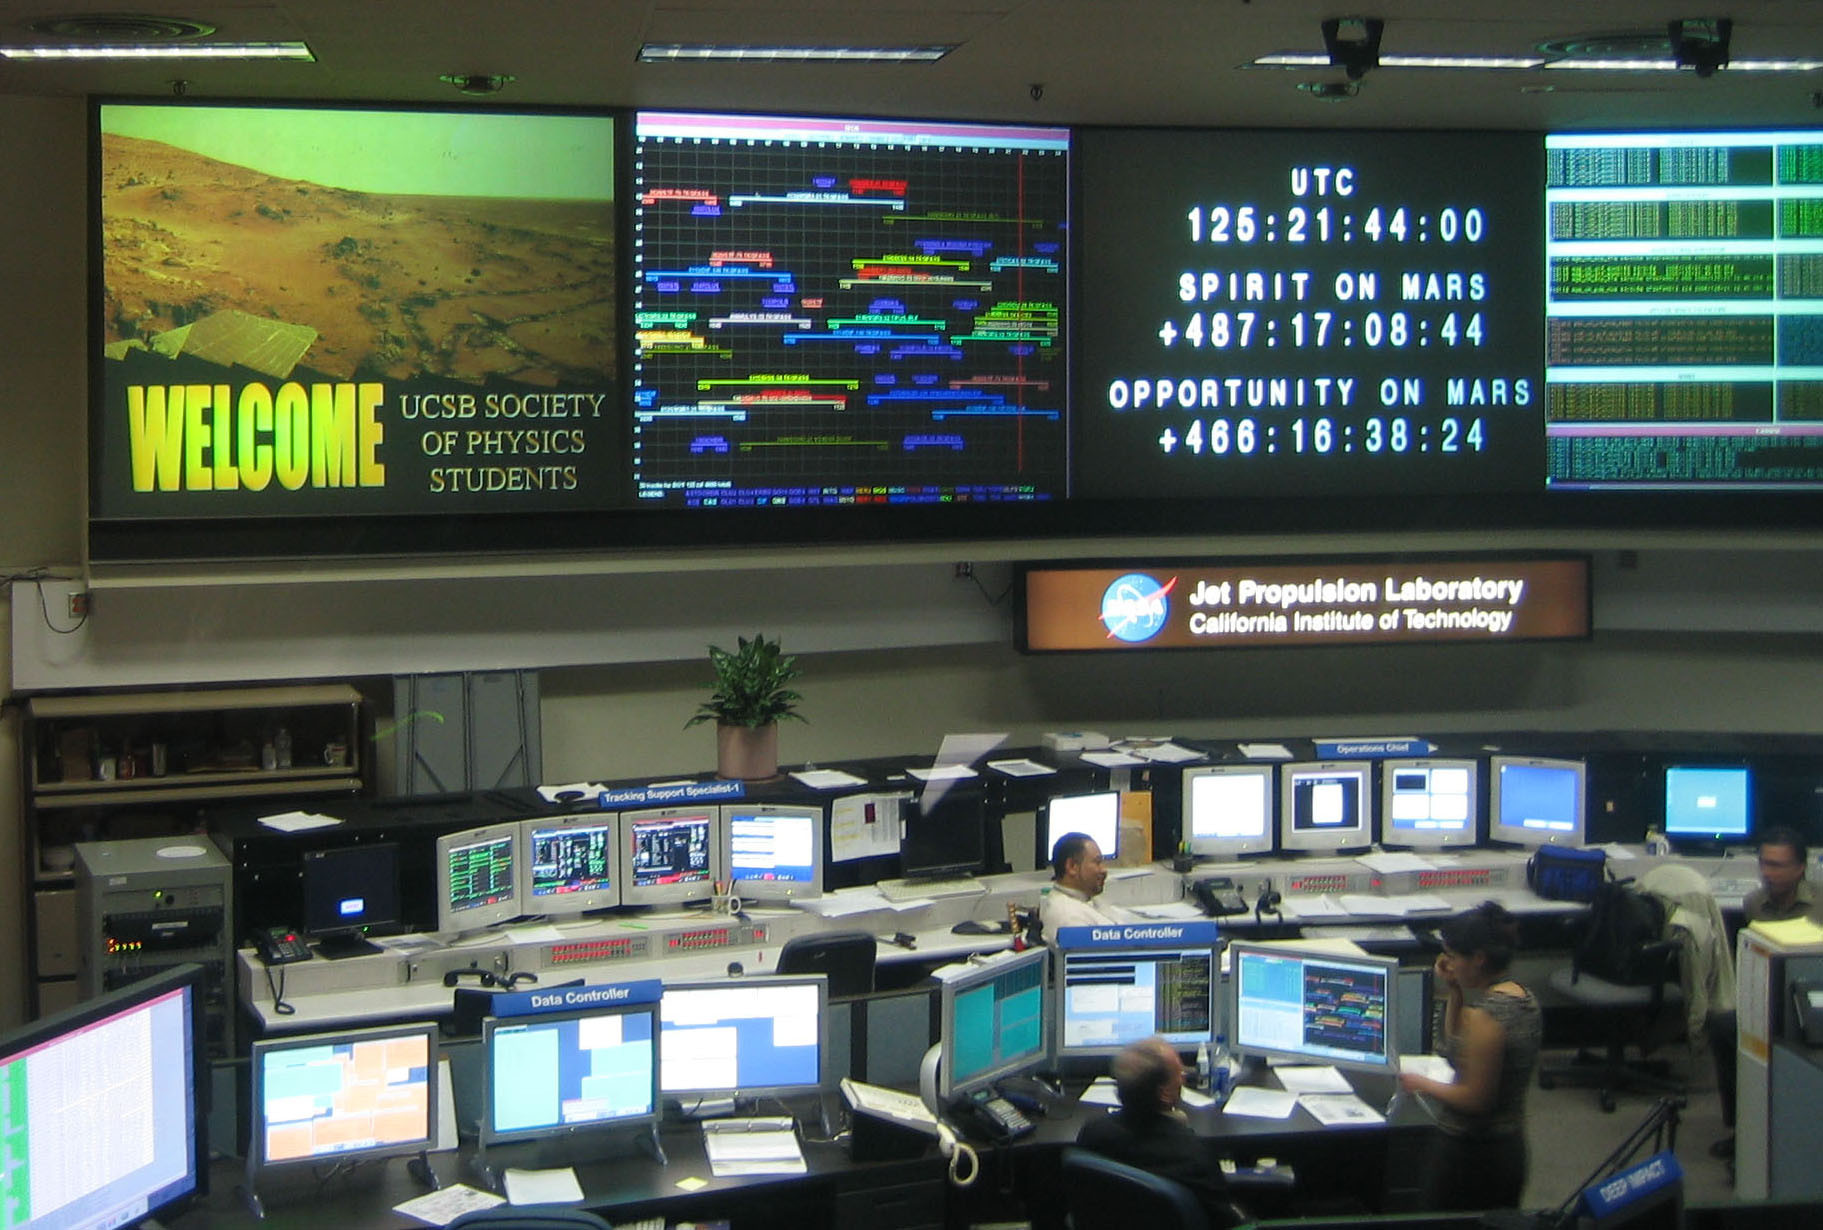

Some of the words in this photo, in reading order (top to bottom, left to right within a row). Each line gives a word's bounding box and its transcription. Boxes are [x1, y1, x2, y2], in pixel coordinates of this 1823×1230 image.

[1291, 168, 1353, 196] UTC
[1188, 207, 1482, 242] 125:21:44:00
[1179, 272, 1309, 301] SPIRIT
[1335, 273, 1377, 301] ON
[1402, 273, 1486, 300] MARS
[1158, 312, 1482, 348] +487:17:08:44
[400, 394, 477, 419] UCSB
[485, 394, 606, 418] SOCIETY
[1109, 379, 1356, 409] OPPORTUNITY
[1380, 379, 1420, 406] ON
[1447, 379, 1529, 405] MARS
[127, 383, 385, 492] WELCOME
[422, 431, 459, 456] OF
[467, 430, 585, 455] PHYSICS
[1158, 418, 1482, 455] +466:16:38:24
[430, 467, 577, 493] STUDENTS
[1189, 581, 1231, 606] Jet
[1238, 578, 1377, 609] Propulsion
[1385, 576, 1524, 605] Laboratory
[1189, 611, 1288, 634] California
[1294, 610, 1374, 633] Institute
[1378, 608, 1399, 630] of
[1402, 607, 1512, 632] Technology
[1336, 743, 1385, 754] Operations
[604, 792, 645, 803] Tracking
[647, 787, 685, 800] Support
[1091, 929, 1121, 941] Data
[1123, 926, 1184, 940] Controller
[530, 995, 563, 1008] Data
[565, 988, 631, 1004] Controller
